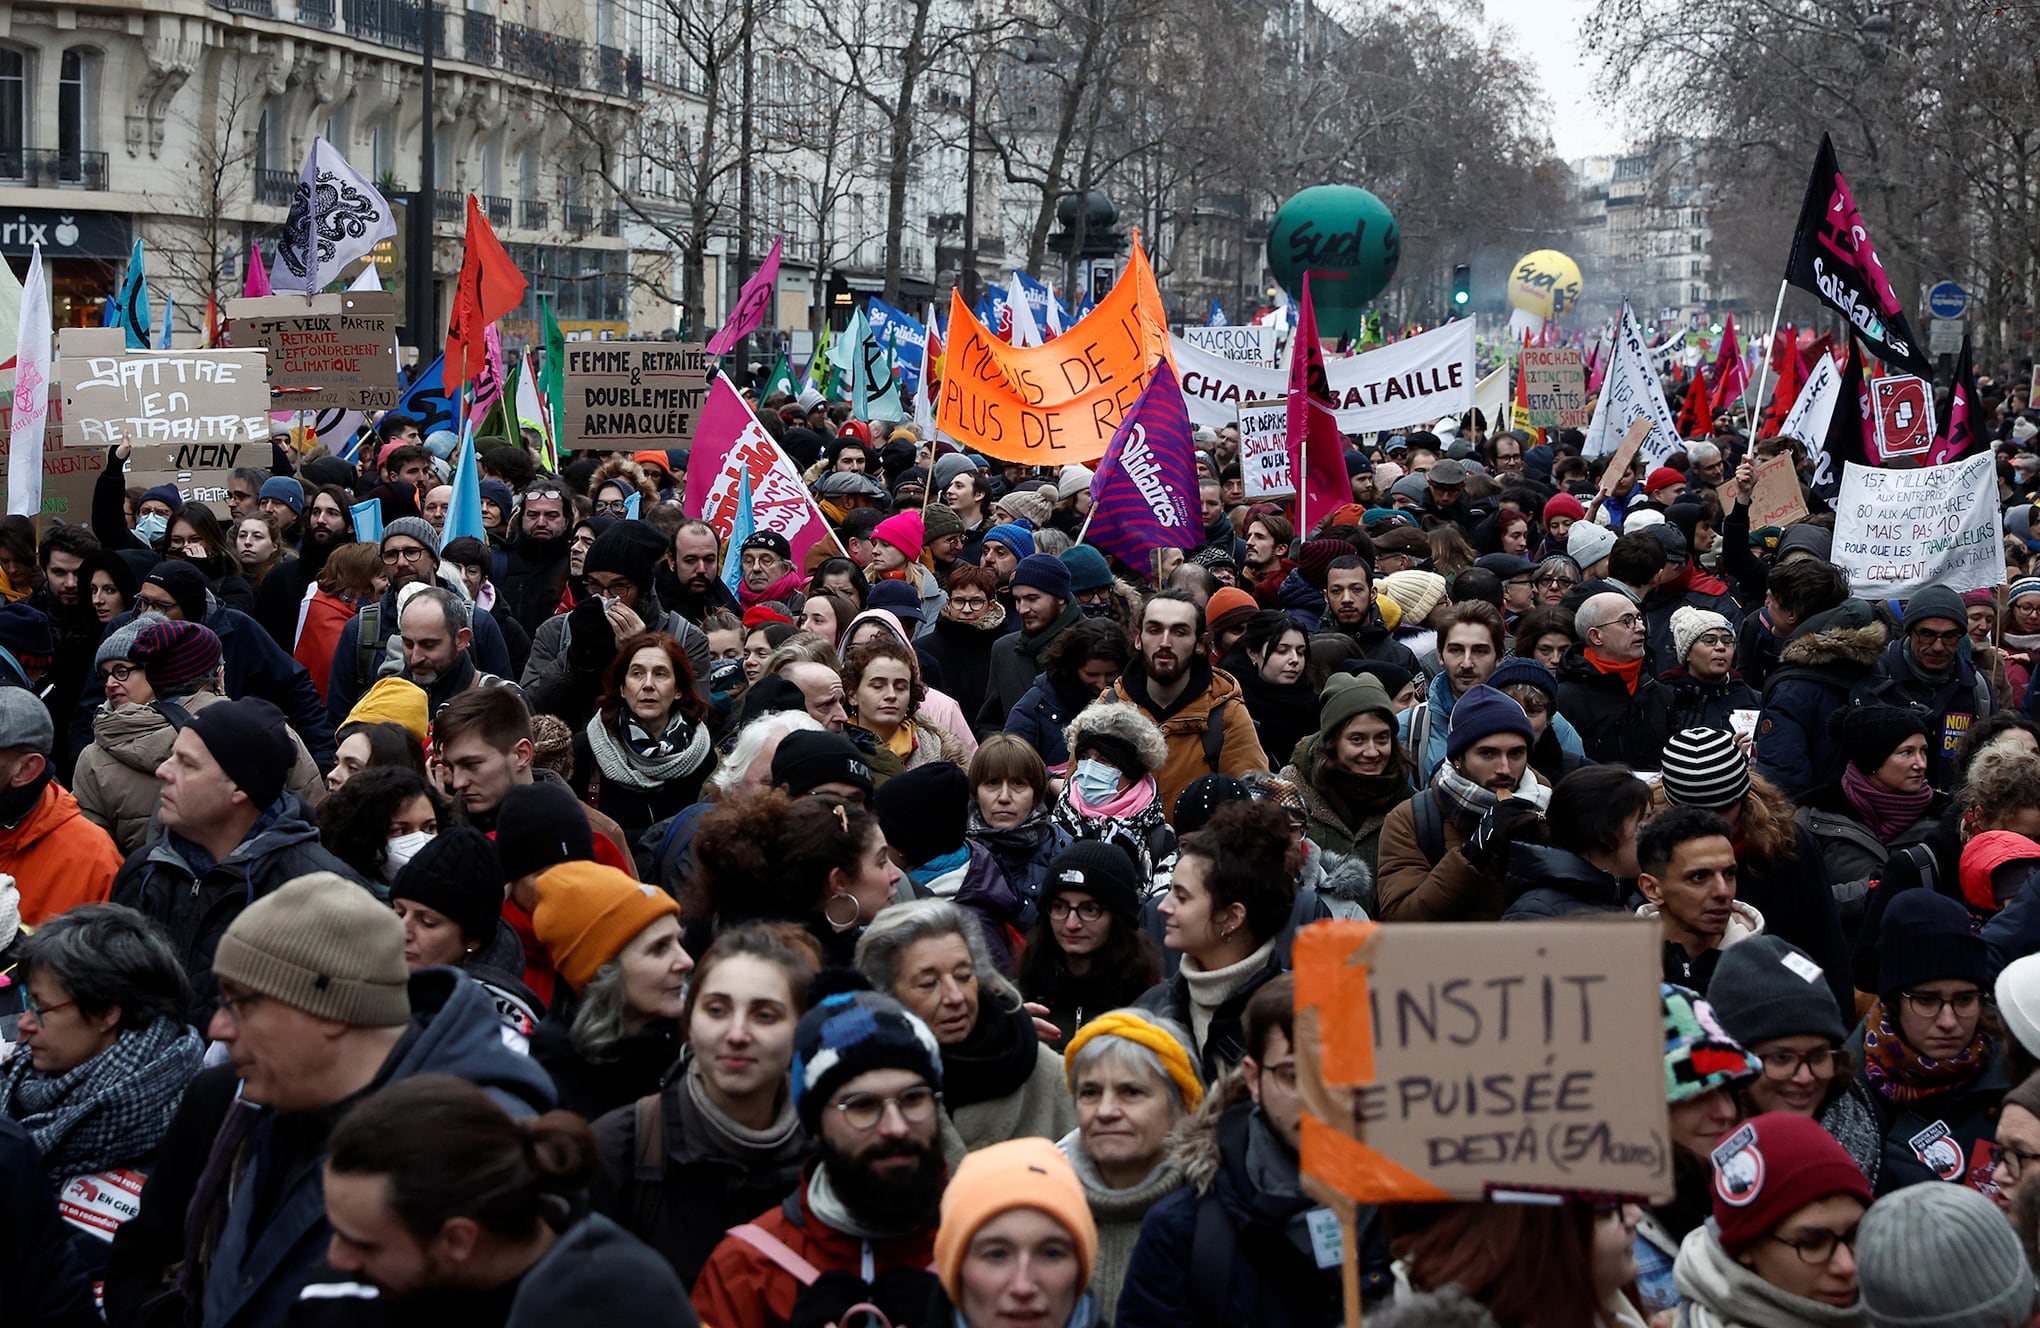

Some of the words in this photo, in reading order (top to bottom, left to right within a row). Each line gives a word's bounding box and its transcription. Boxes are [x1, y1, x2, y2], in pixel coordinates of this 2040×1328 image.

[0, 214, 48, 246] rix
[260, 321, 289, 335] JE
[293, 318, 331, 331] VEUX
[340, 318, 386, 332] PARTIR
[258, 337, 272, 347] EN
[280, 332, 340, 347] RETRAITE
[1189, 330, 1260, 349] MACRON
[275, 345, 380, 360] L'EFFONDREMENT
[569, 351, 630, 373] FEMME
[1525, 351, 1582, 366] PROCHAIN
[75, 358, 242, 391] BATTRE
[284, 358, 361, 373] CLIMATIQUE
[1060, 343, 1113, 395] DE
[630, 367, 642, 385] &
[584, 387, 706, 409] DOUBLEMENT
[1527, 391, 1580, 409] RETRAITÉS
[583, 410, 690, 436] ARNAQUÉE
[944, 379, 1003, 441] PLUS
[1021, 411, 1066, 449] DE
[1560, 407, 1586, 425] SANTÉ
[1242, 416, 1256, 435] JE
[175, 443, 242, 469] NON
[1861, 472, 1887, 488] 157
[1857, 504, 1873, 519] 80
[1878, 510, 1897, 519] AUX
[1866, 522, 1902, 540] MAIS
[1912, 524, 1933, 541] PAS
[1937, 514, 1961, 536] 10
[1845, 542, 1867, 554] POUR
[1870, 545, 1889, 557] QUE
[1893, 545, 1912, 557] LES
[1920, 522, 1995, 557] TRAVAILLEURS
[1867, 560, 1927, 582] CRÈVENT
[1946, 714, 1970, 730] NON
[1369, 948, 1606, 1048] INSTIT
[97, 1192, 114, 1206] EN
